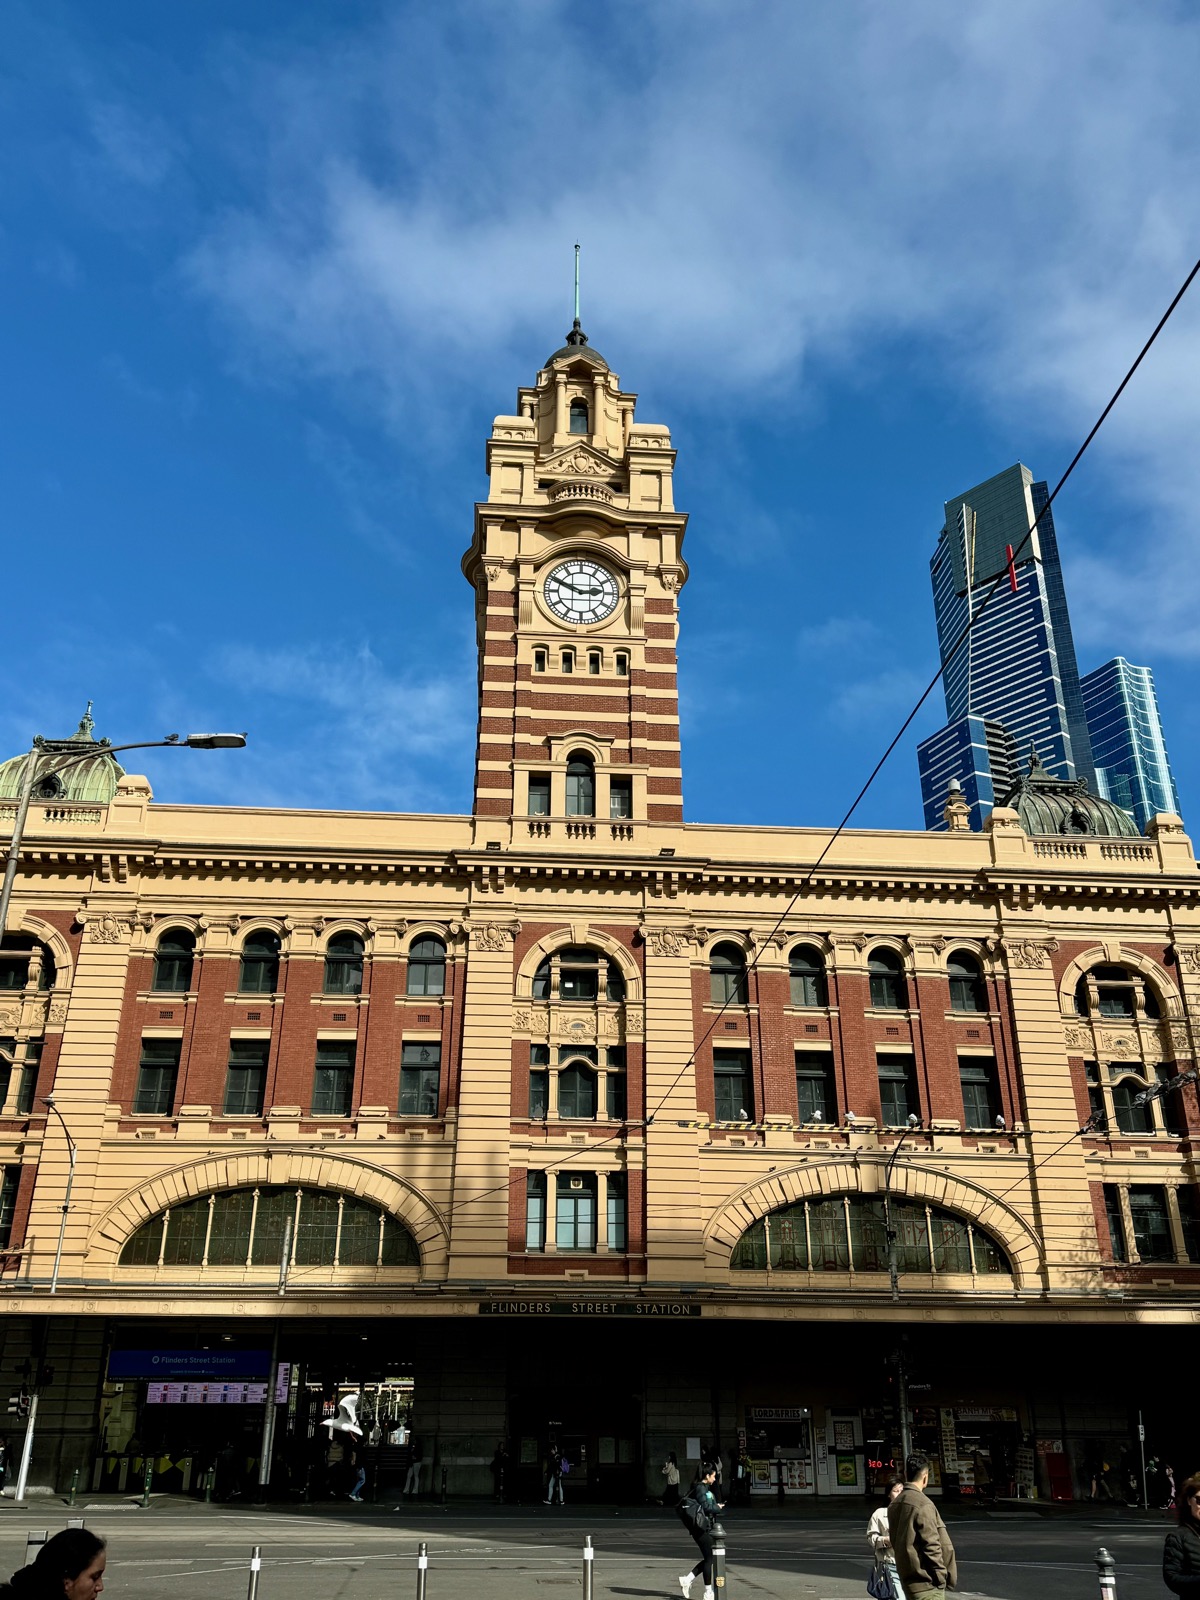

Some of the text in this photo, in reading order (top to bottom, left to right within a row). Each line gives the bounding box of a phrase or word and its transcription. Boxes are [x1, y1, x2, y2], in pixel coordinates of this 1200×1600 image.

[491, 1302, 691, 1315] FLINDERS STREET STATION
[161, 1356, 236, 1364] Flinders Street Station
[754, 1409, 774, 1418] LORD
[781, 1409, 801, 1418] FRIES
